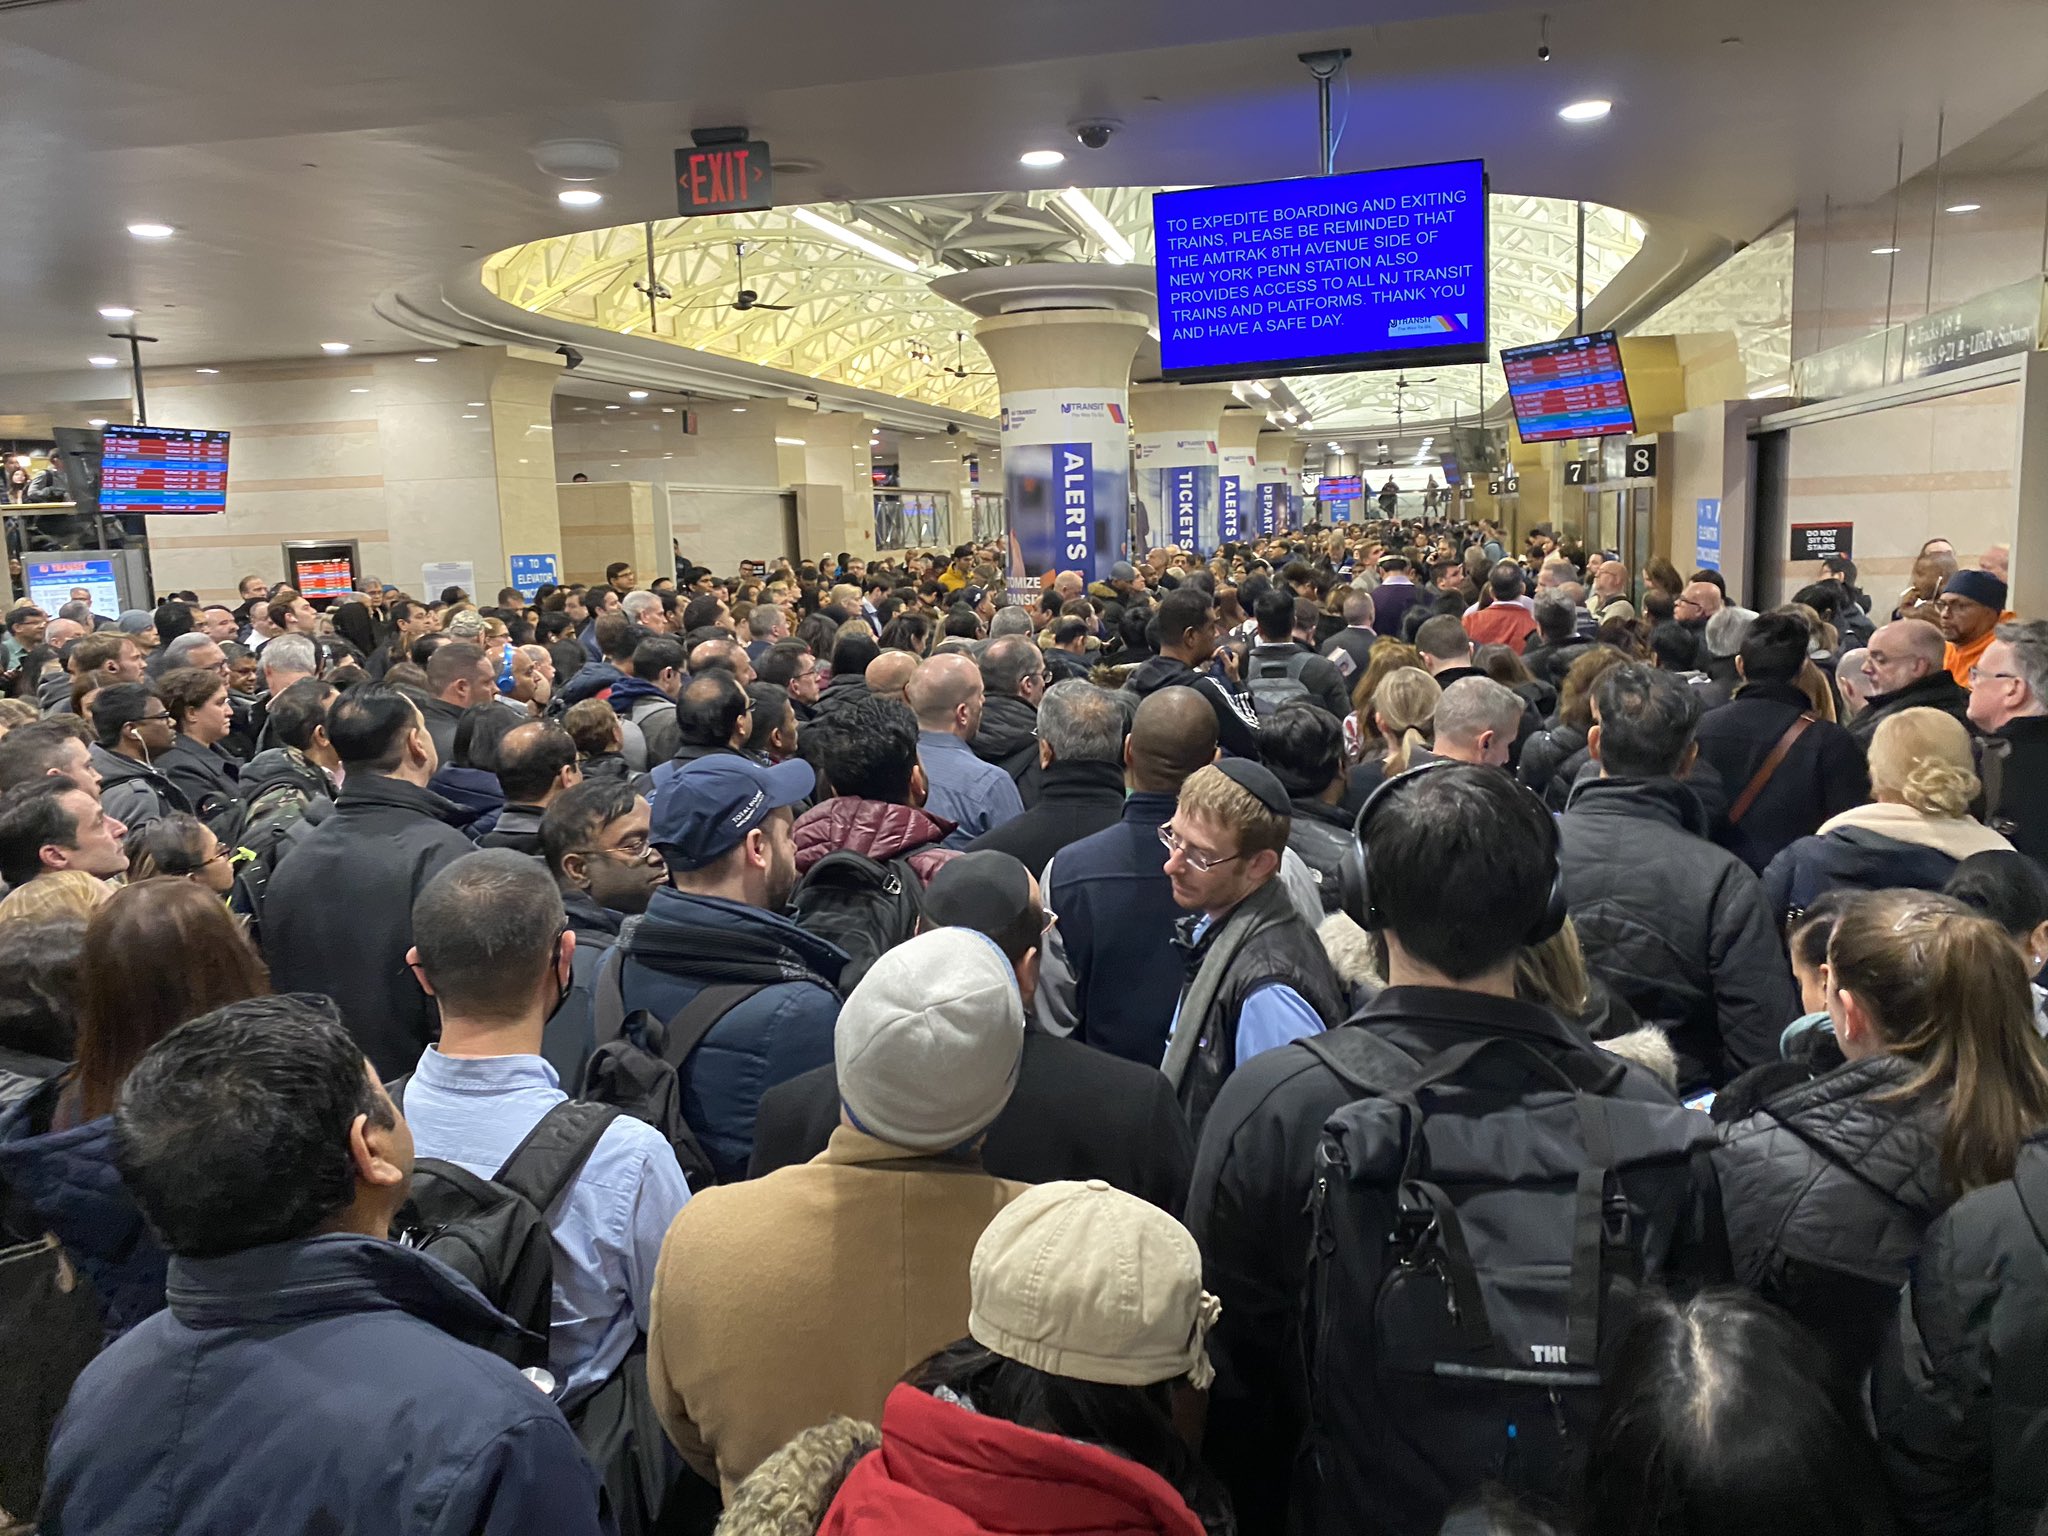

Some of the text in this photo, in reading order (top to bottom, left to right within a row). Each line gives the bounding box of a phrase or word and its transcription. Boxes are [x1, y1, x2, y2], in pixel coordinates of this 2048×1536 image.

[689, 150, 749, 205] EXIT
[1167, 190, 1466, 232] TO EXPEDITE BOARDING AND EXITING
[1233, 226, 1293, 244] PLEASE
[1298, 224, 1319, 237] BE
[1324, 215, 1409, 234] REMINDED
[1414, 210, 1455, 226] THAT
[1169, 231, 1438, 268] THE AMTRAK 8TH AVENUE SIDE OF
[1170, 252, 1418, 286] NEW YORK PENN STATION ALSO
[1171, 265, 1472, 304] PROVIDES ACCESS TO ALL NJ TRANSIT
[1172, 306, 1226, 322] TRAINS
[1231, 303, 1263, 317] AND
[1372, 288, 1426, 303] THANK
[1430, 284, 1465, 298] YOU
[1173, 327, 1204, 340] AND
[1209, 322, 1248, 336] HAVE
[1253, 321, 1263, 333] A
[1267, 317, 1306, 332] SAFE
[1061, 403, 1105, 414] NJ TRANSIT
[1570, 464, 1581, 482] 7
[1633, 449, 1649, 472] 8
[1491, 483, 1498, 494] 5
[1508, 479, 1516, 491] 6
[1064, 452, 1087, 560] ALERTS
[1179, 471, 1194, 550] TICKETS
[1225, 480, 1237, 537] ALERTS
[1263, 485, 1273, 533] DEPART
[1820, 529, 1837, 537] NOT
[517, 572, 553, 585] ELEVATOR
[529, 558, 540, 569] TO
[732, 806, 751, 823] TOTAL
